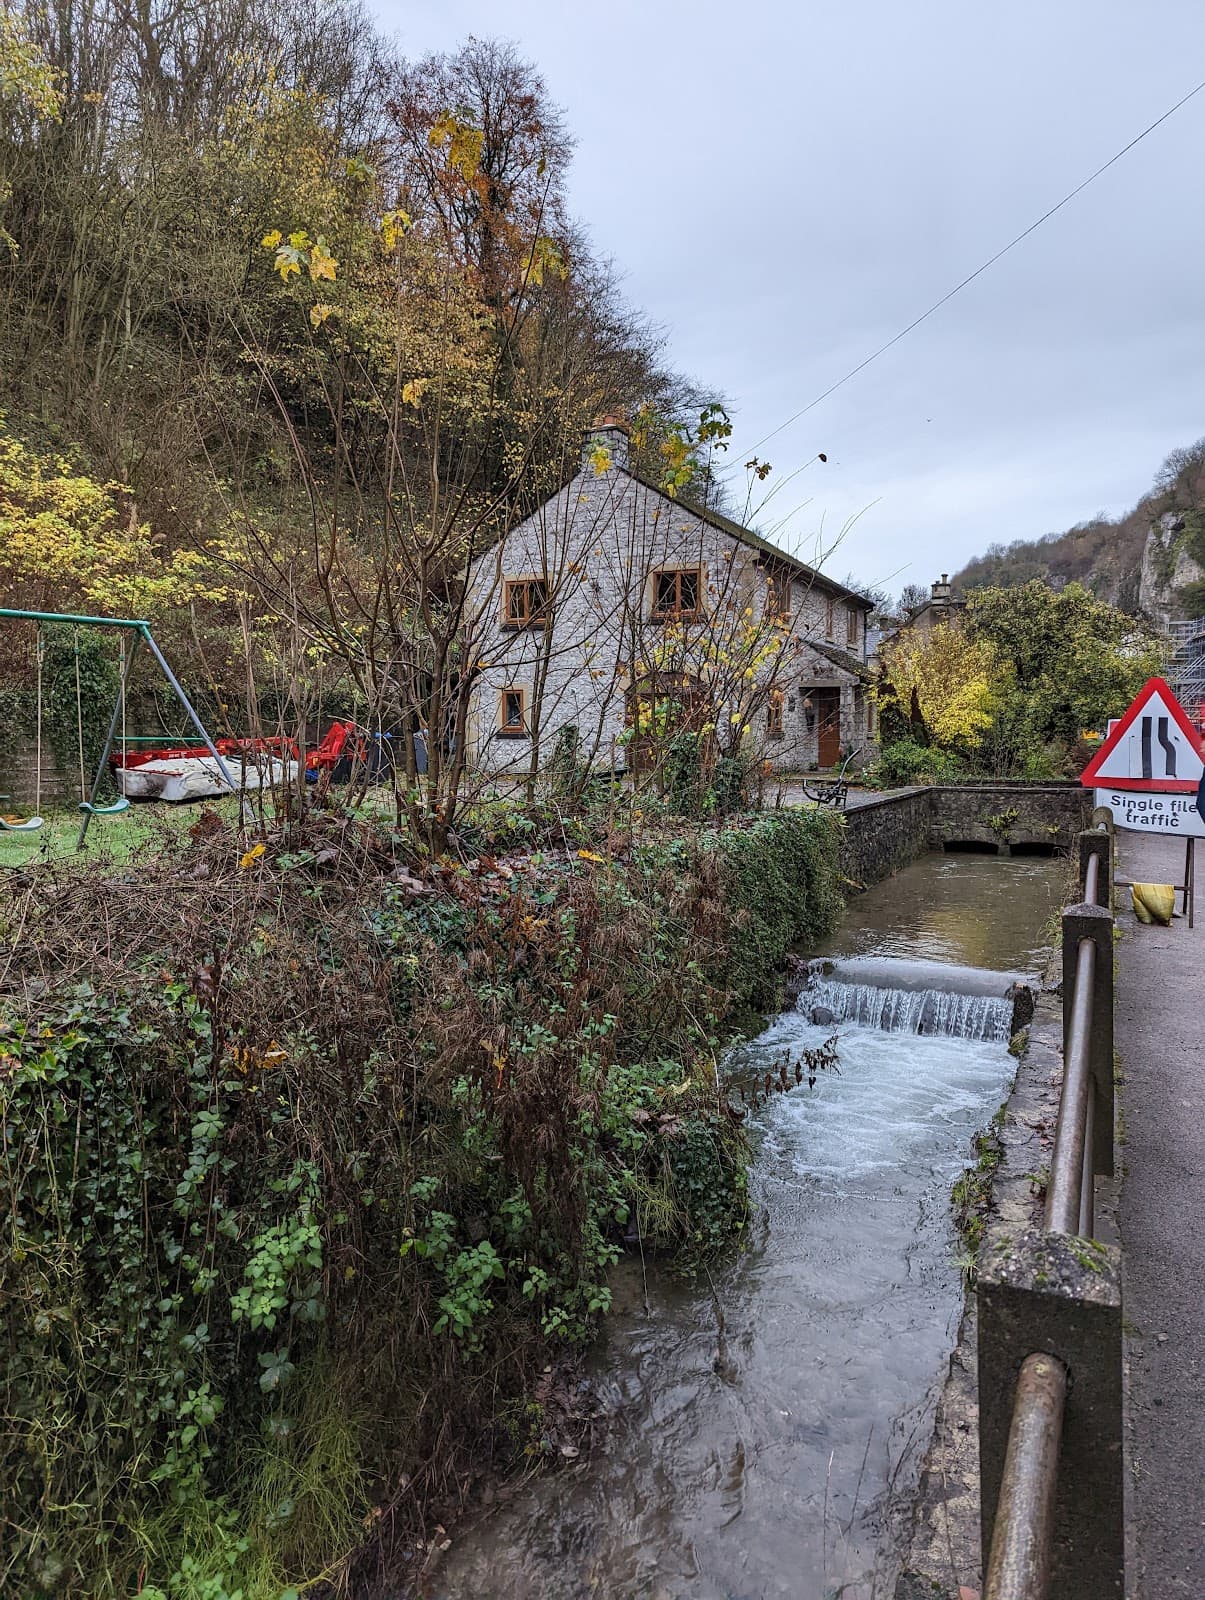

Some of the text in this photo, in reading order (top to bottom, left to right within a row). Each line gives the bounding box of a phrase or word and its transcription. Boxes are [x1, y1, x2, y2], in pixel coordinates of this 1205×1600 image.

[1110, 794, 1198, 814] Single file
[1126, 812, 1180, 828] traffic
